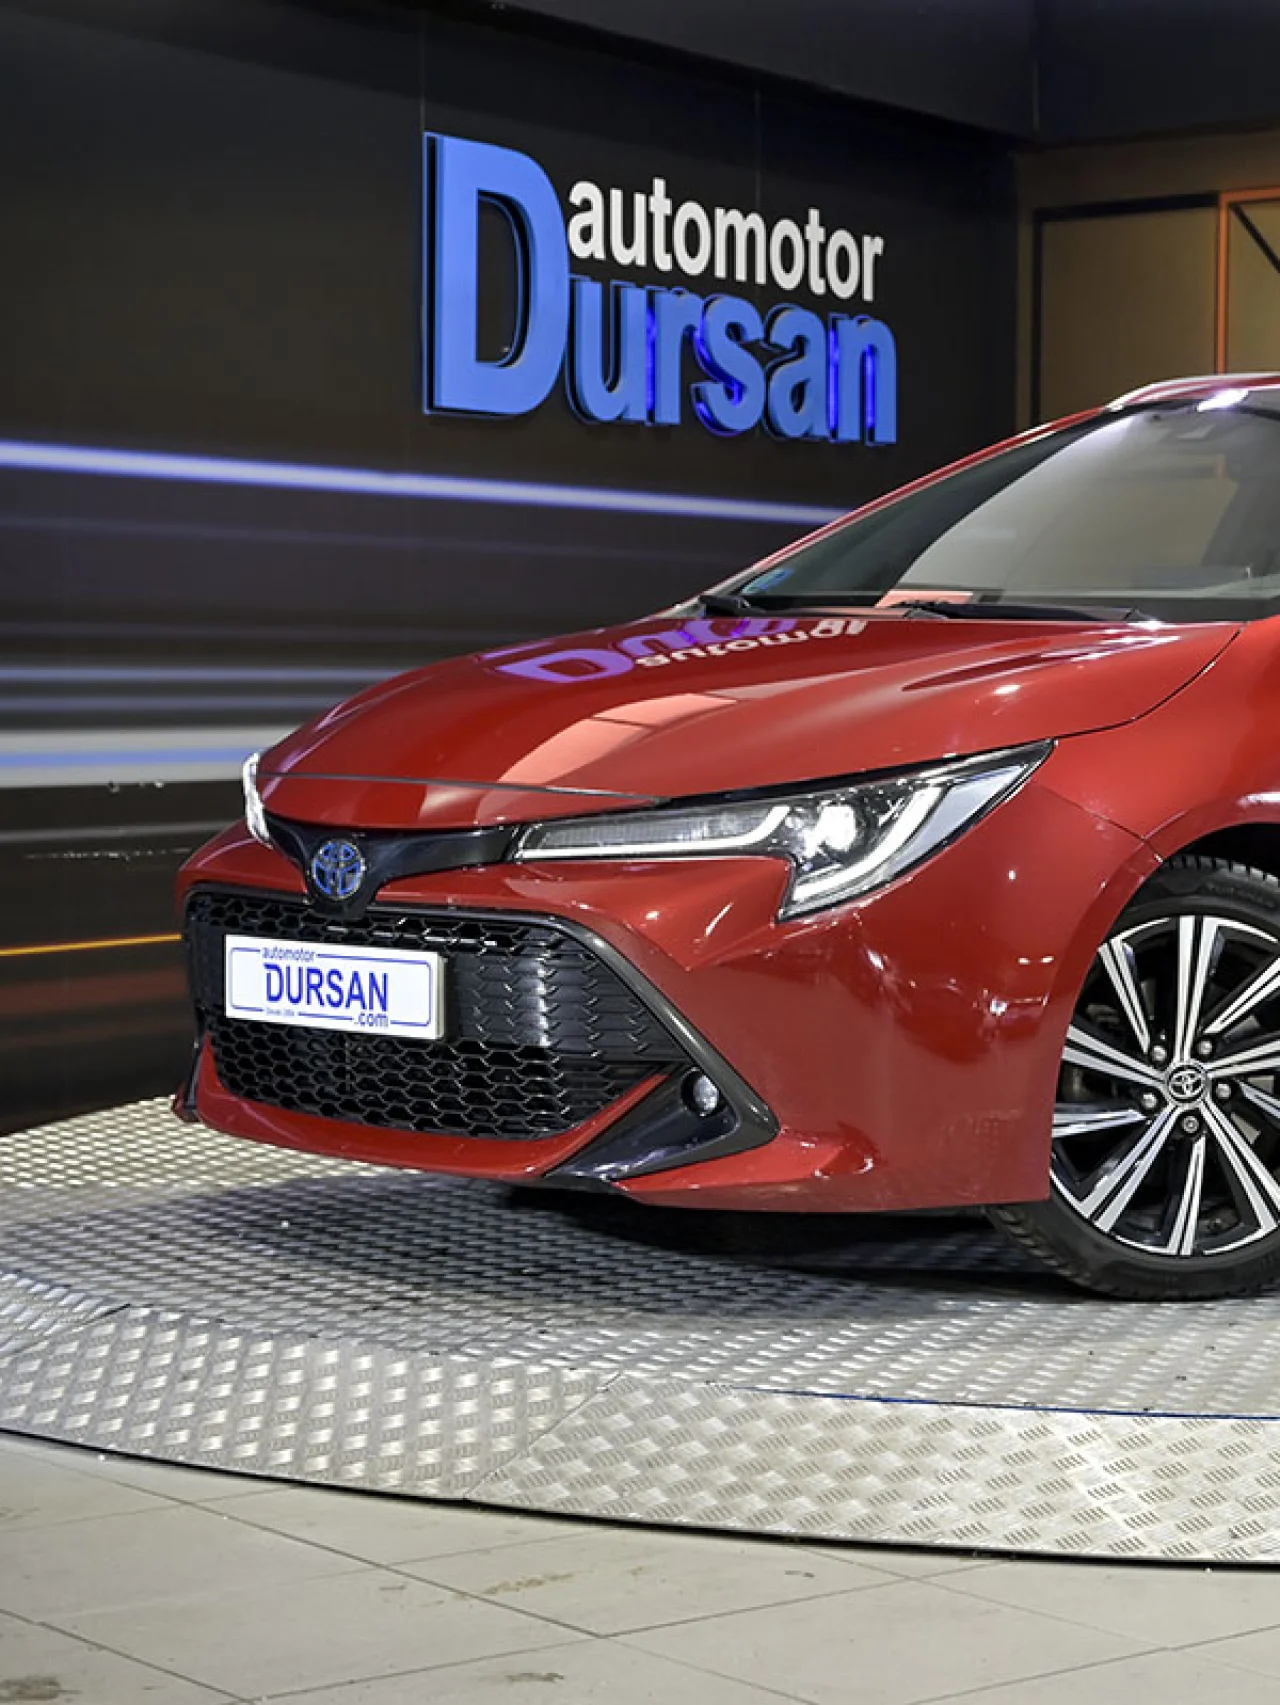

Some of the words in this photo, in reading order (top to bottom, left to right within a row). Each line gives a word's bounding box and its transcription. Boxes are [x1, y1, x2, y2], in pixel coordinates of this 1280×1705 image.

[567, 177, 884, 302] automotor
[424, 131, 897, 446] Dursan
[261, 946, 315, 963] automotor
[263, 963, 389, 1012] DURSAN
